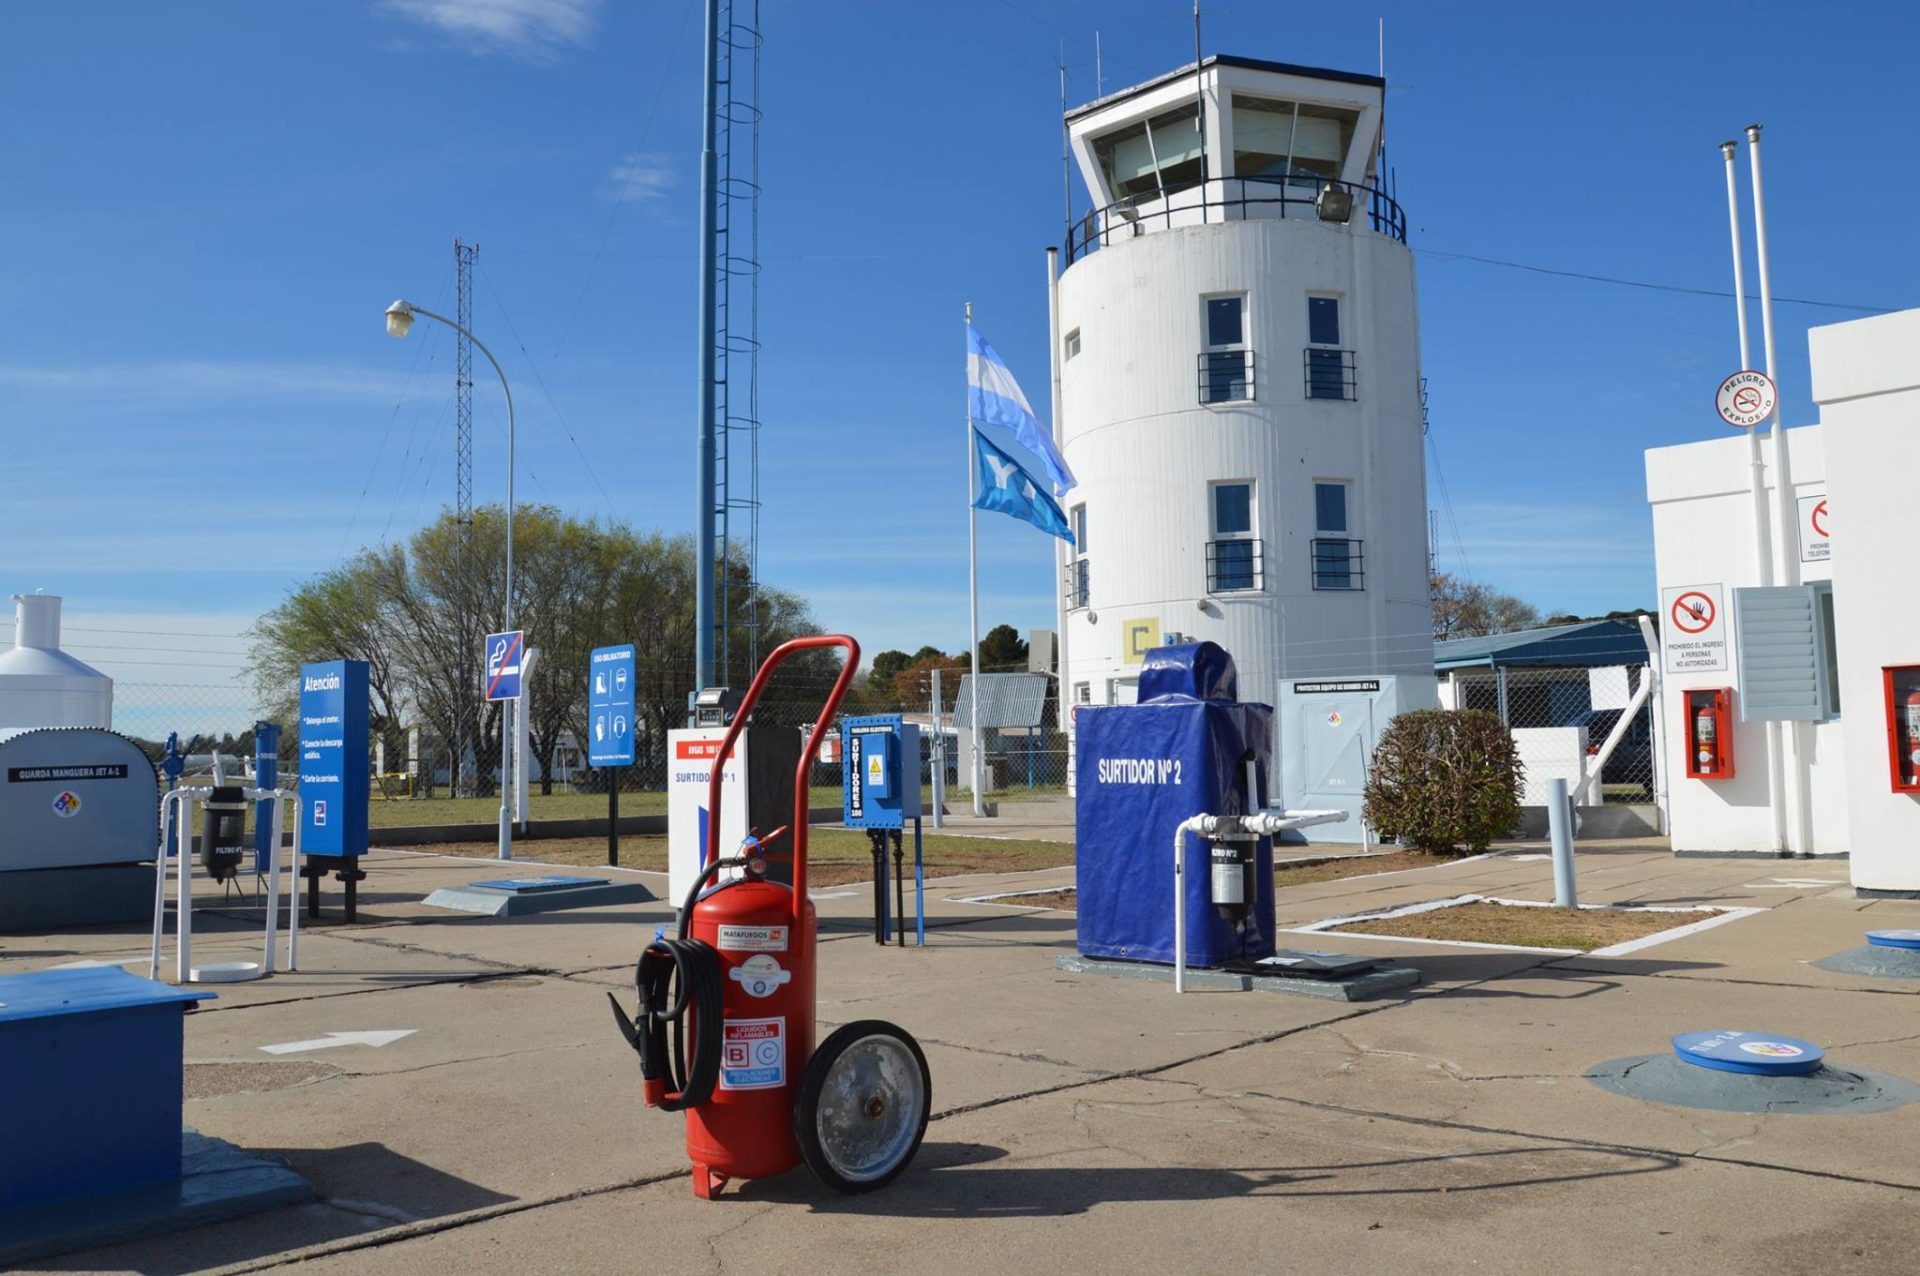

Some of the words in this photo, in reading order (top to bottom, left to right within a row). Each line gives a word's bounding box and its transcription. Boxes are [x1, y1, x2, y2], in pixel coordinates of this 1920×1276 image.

[1724, 374, 1765, 392] PELIGRO
[1667, 642, 1695, 650] PROHIBIDO
[1695, 641, 1701, 649] EL
[1702, 640, 1724, 648] INGRESO
[1685, 650, 1711, 658] PERSONAS
[1684, 659, 1718, 667] AUTORIZADAS
[304, 672, 340, 692] Atención
[19, 769, 51, 780] GUARDA
[52, 767, 94, 779] MANGUERA
[95, 767, 107, 777] JET
[108, 766, 120, 777] A-1
[676, 772, 710, 782] SURTIDO
[851, 738, 860, 809] SURTIDORES
[1098, 758, 1155, 784] SURTIDOR
[1174, 759, 1182, 784] 2
[851, 809, 862, 817] 100
[730, 1049, 744, 1061] B
[763, 1047, 773, 1058] C
